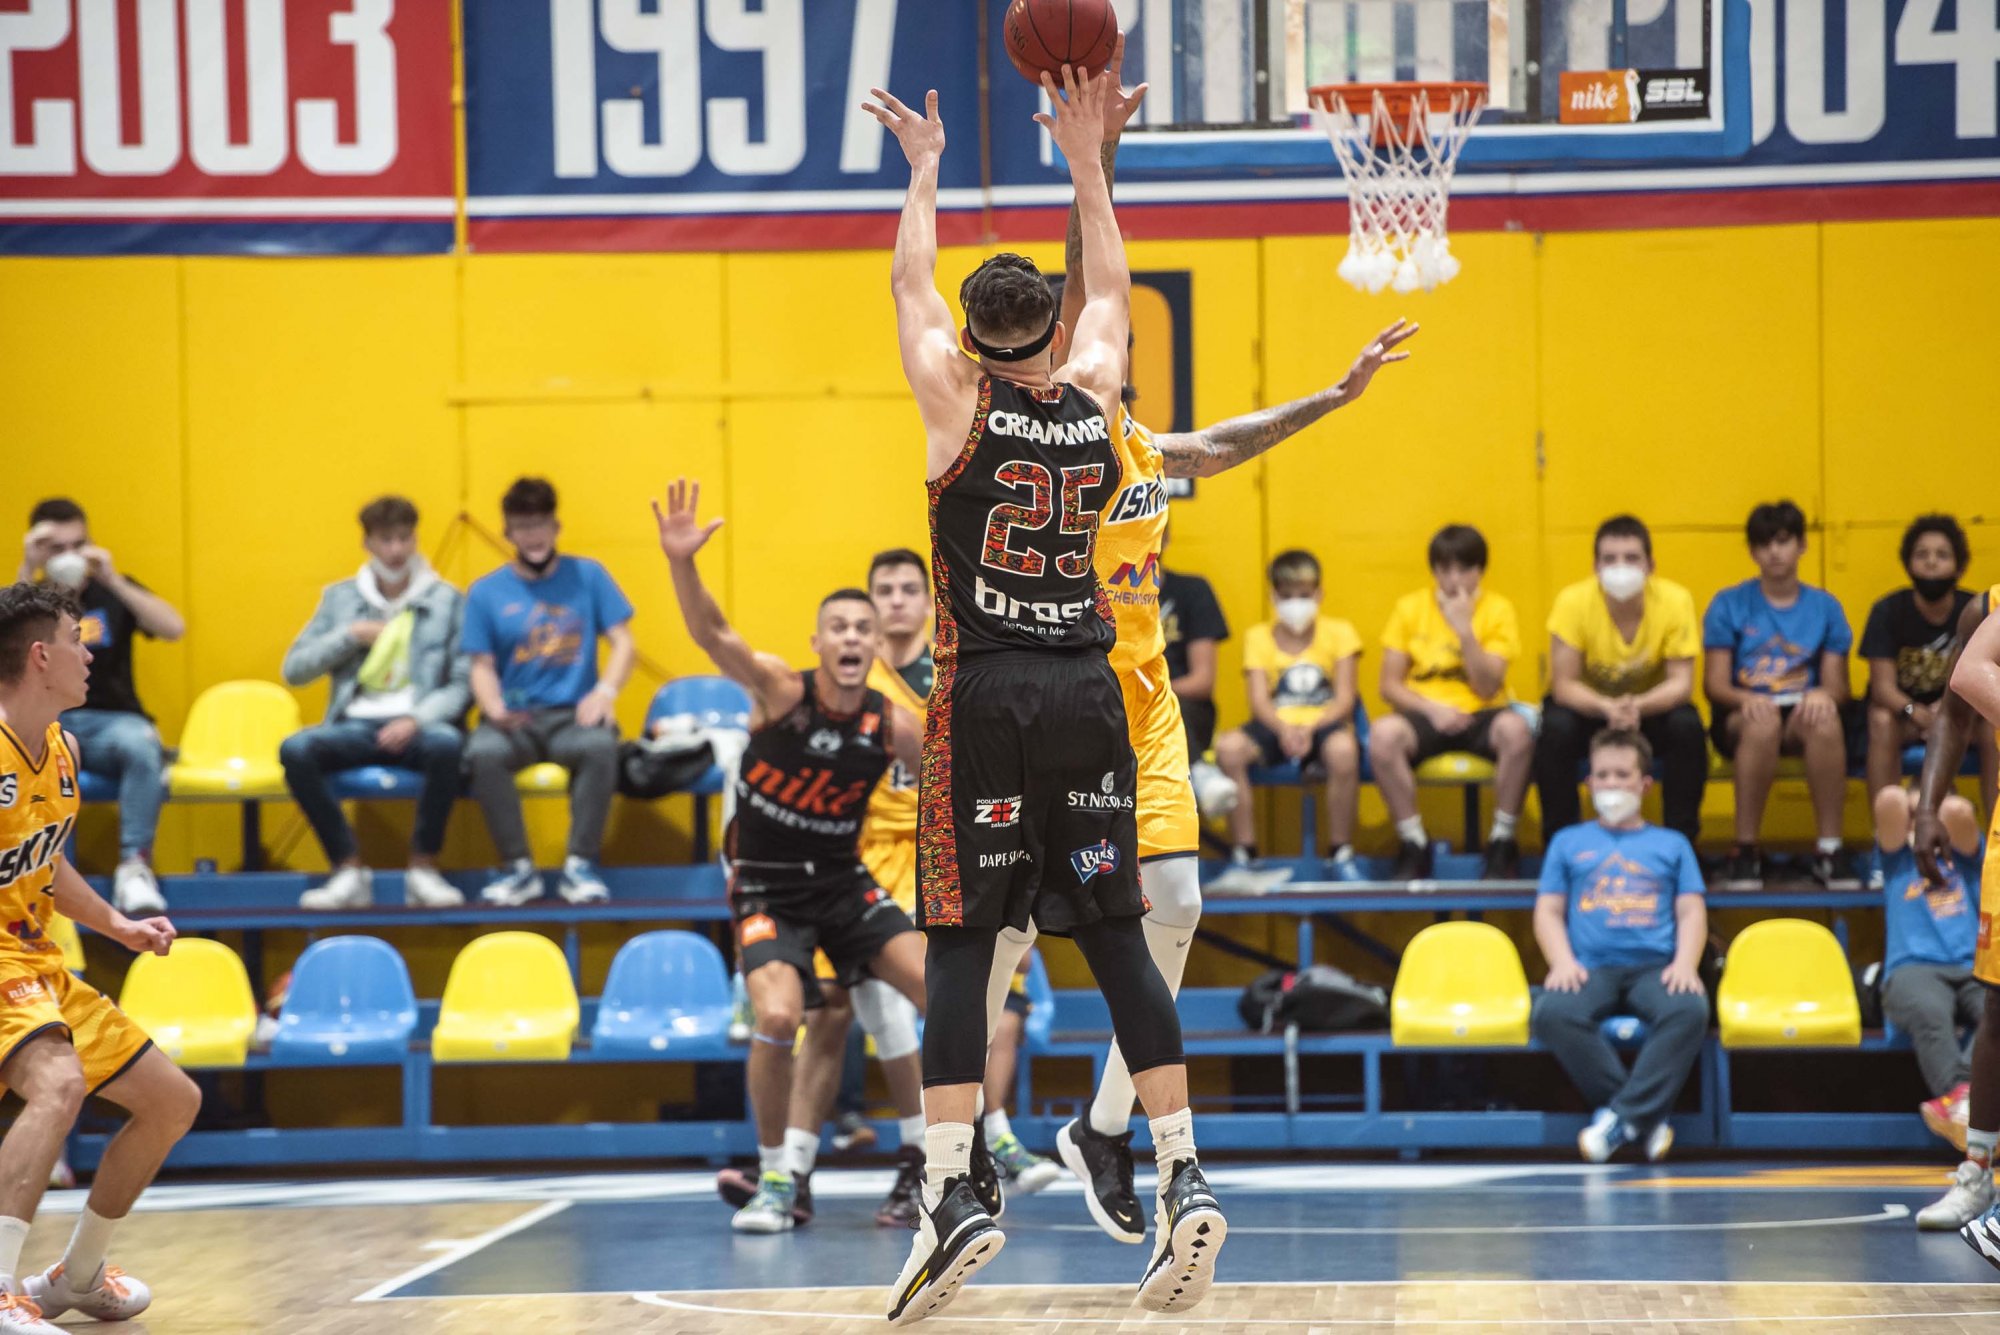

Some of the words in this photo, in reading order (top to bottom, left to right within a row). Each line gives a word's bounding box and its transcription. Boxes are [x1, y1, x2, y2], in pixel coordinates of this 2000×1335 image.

[1644, 77, 1704, 103] SBL
[980, 459, 1104, 578] 25
[1037, 625, 1047, 635] in
[979, 852, 1008, 868] DAPE
